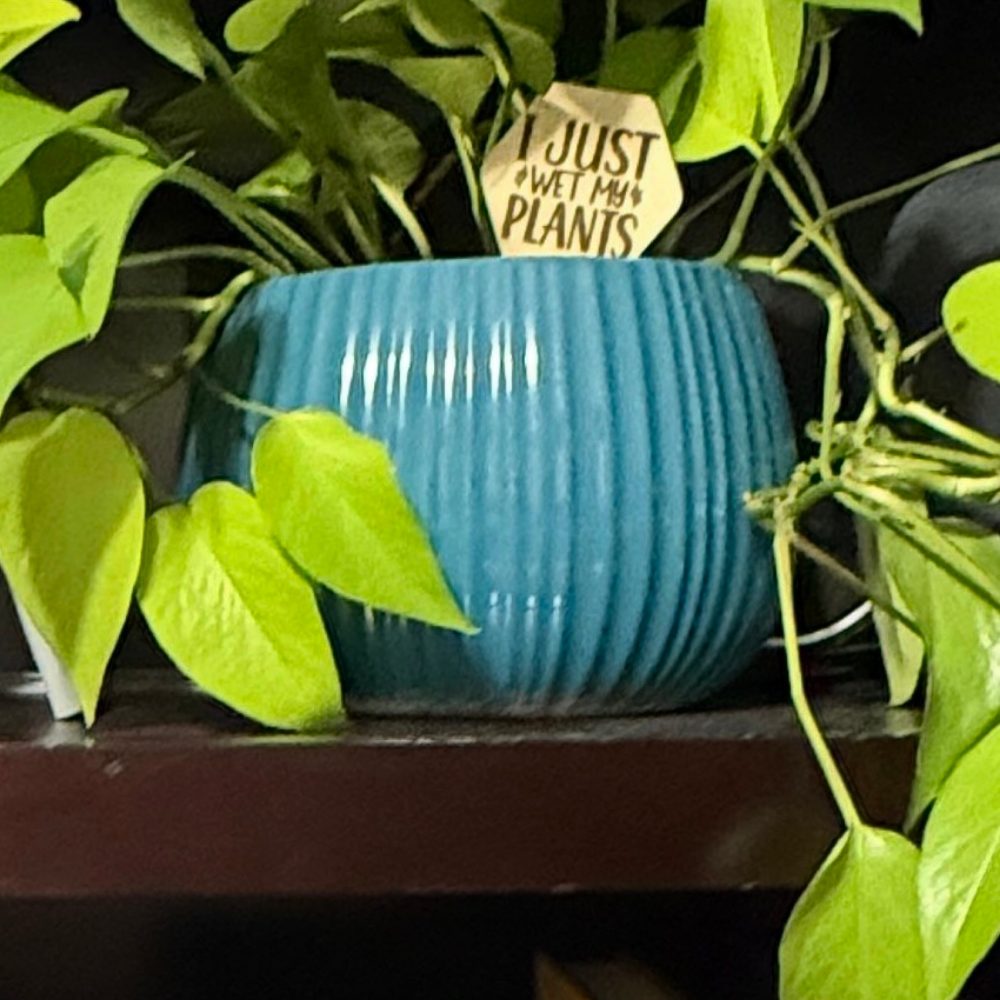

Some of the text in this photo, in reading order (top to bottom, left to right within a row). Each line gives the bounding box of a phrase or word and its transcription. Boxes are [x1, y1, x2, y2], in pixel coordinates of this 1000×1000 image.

[517, 114, 661, 181] I JUST
[531, 165, 629, 208] WET MY
[501, 193, 639, 259] PLANTS
